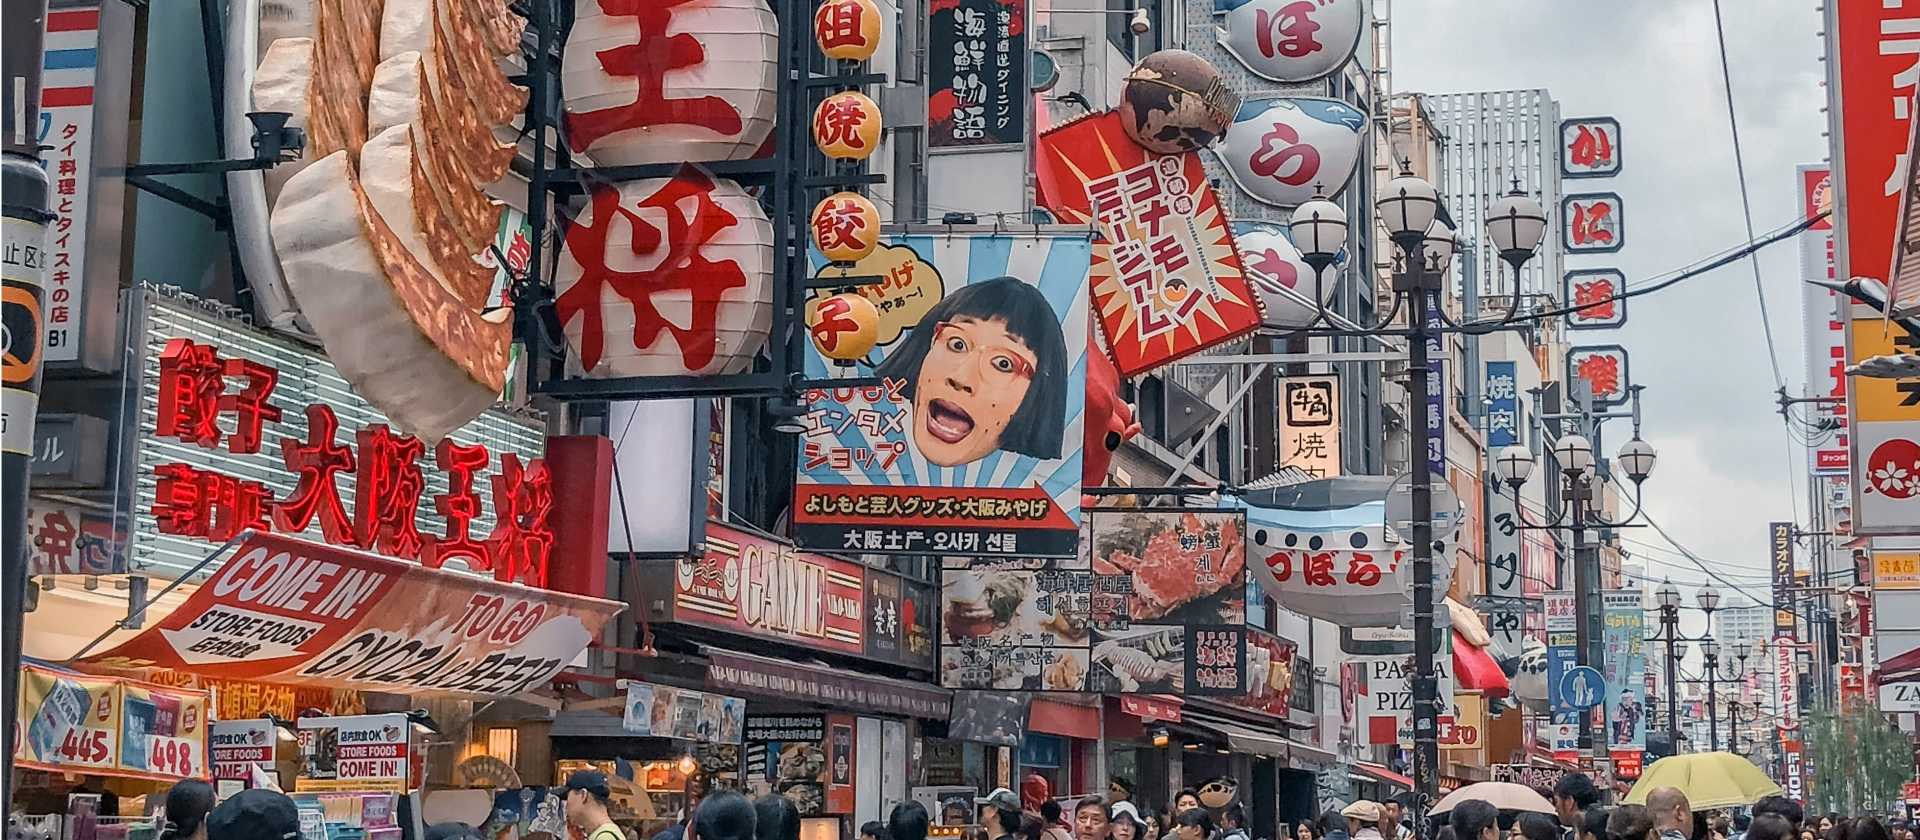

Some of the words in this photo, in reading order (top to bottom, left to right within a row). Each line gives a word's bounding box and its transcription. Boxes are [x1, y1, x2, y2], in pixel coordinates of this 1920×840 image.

[952, 8, 987, 139] 海鮮物語
[51, 123, 77, 323] タイ料理とタイスキの店
[48, 330, 67, 347] B1
[1293, 390, 1328, 417] 牛角
[1488, 374, 1516, 436] 焼肉
[805, 408, 907, 438] エンタメ
[804, 440, 906, 471] ショップ
[985, 532, 1017, 553] 선물
[1776, 526, 1790, 573] カラオケ
[213, 546, 341, 611] COME
[311, 567, 386, 620] IN!
[1266, 550, 1403, 587] づぼら
[190, 610, 262, 638] STORE
[251, 619, 317, 647] FOODS
[452, 594, 501, 638] TO
[491, 601, 546, 643] GO
[1374, 661, 1448, 679] PAA
[61, 727, 109, 763] 445
[152, 738, 192, 777] 498
[233, 747, 263, 761] FOODS
[340, 747, 368, 757] STORE
[368, 745, 397, 757] FOODS
[214, 763, 241, 778] OME
[339, 763, 376, 778] COME
[380, 760, 398, 777] IN!
